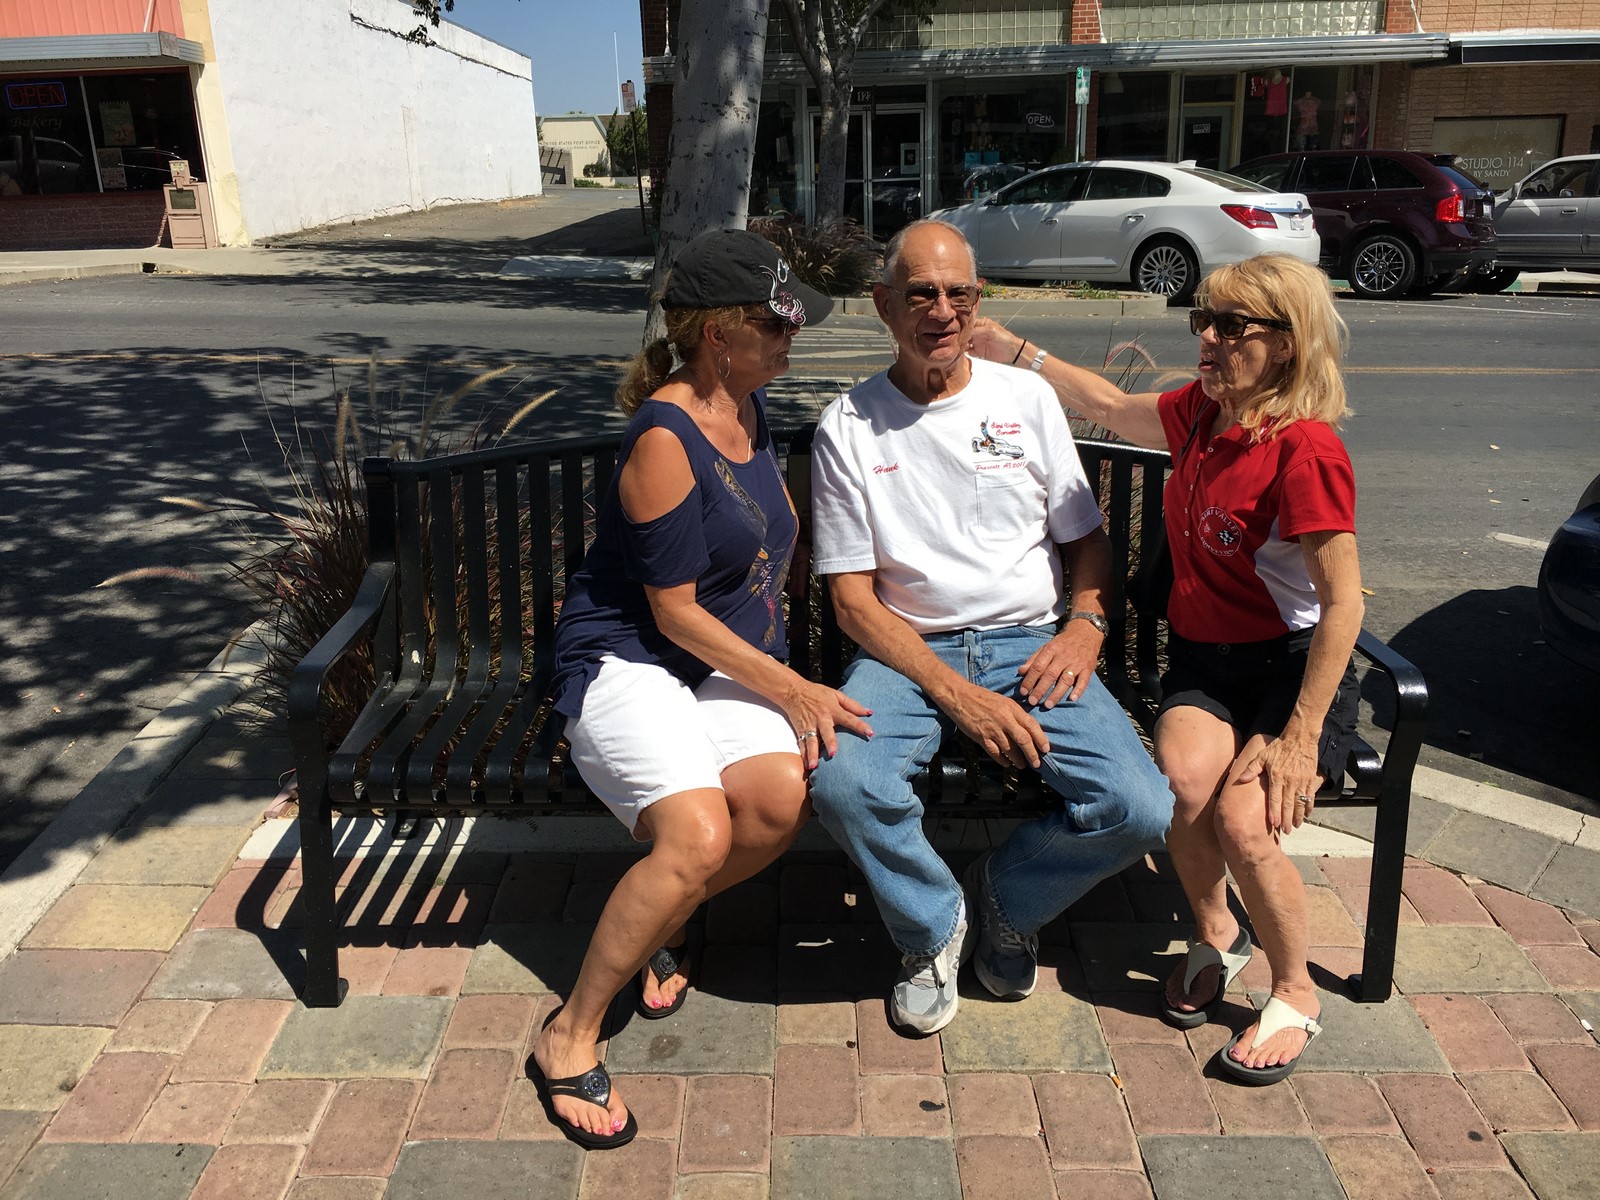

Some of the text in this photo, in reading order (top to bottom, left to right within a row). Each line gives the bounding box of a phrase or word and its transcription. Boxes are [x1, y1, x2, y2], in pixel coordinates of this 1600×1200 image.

[10, 86, 64, 106] OPEN
[10, 117, 62, 129] Bakery
[1027, 115, 1052, 125] OPEN
[1461, 156, 1524, 170] STUDIO 114
[1473, 170, 1483, 178] BY
[872, 461, 898, 475] Hank
[1214, 509, 1240, 536] VALLEY
